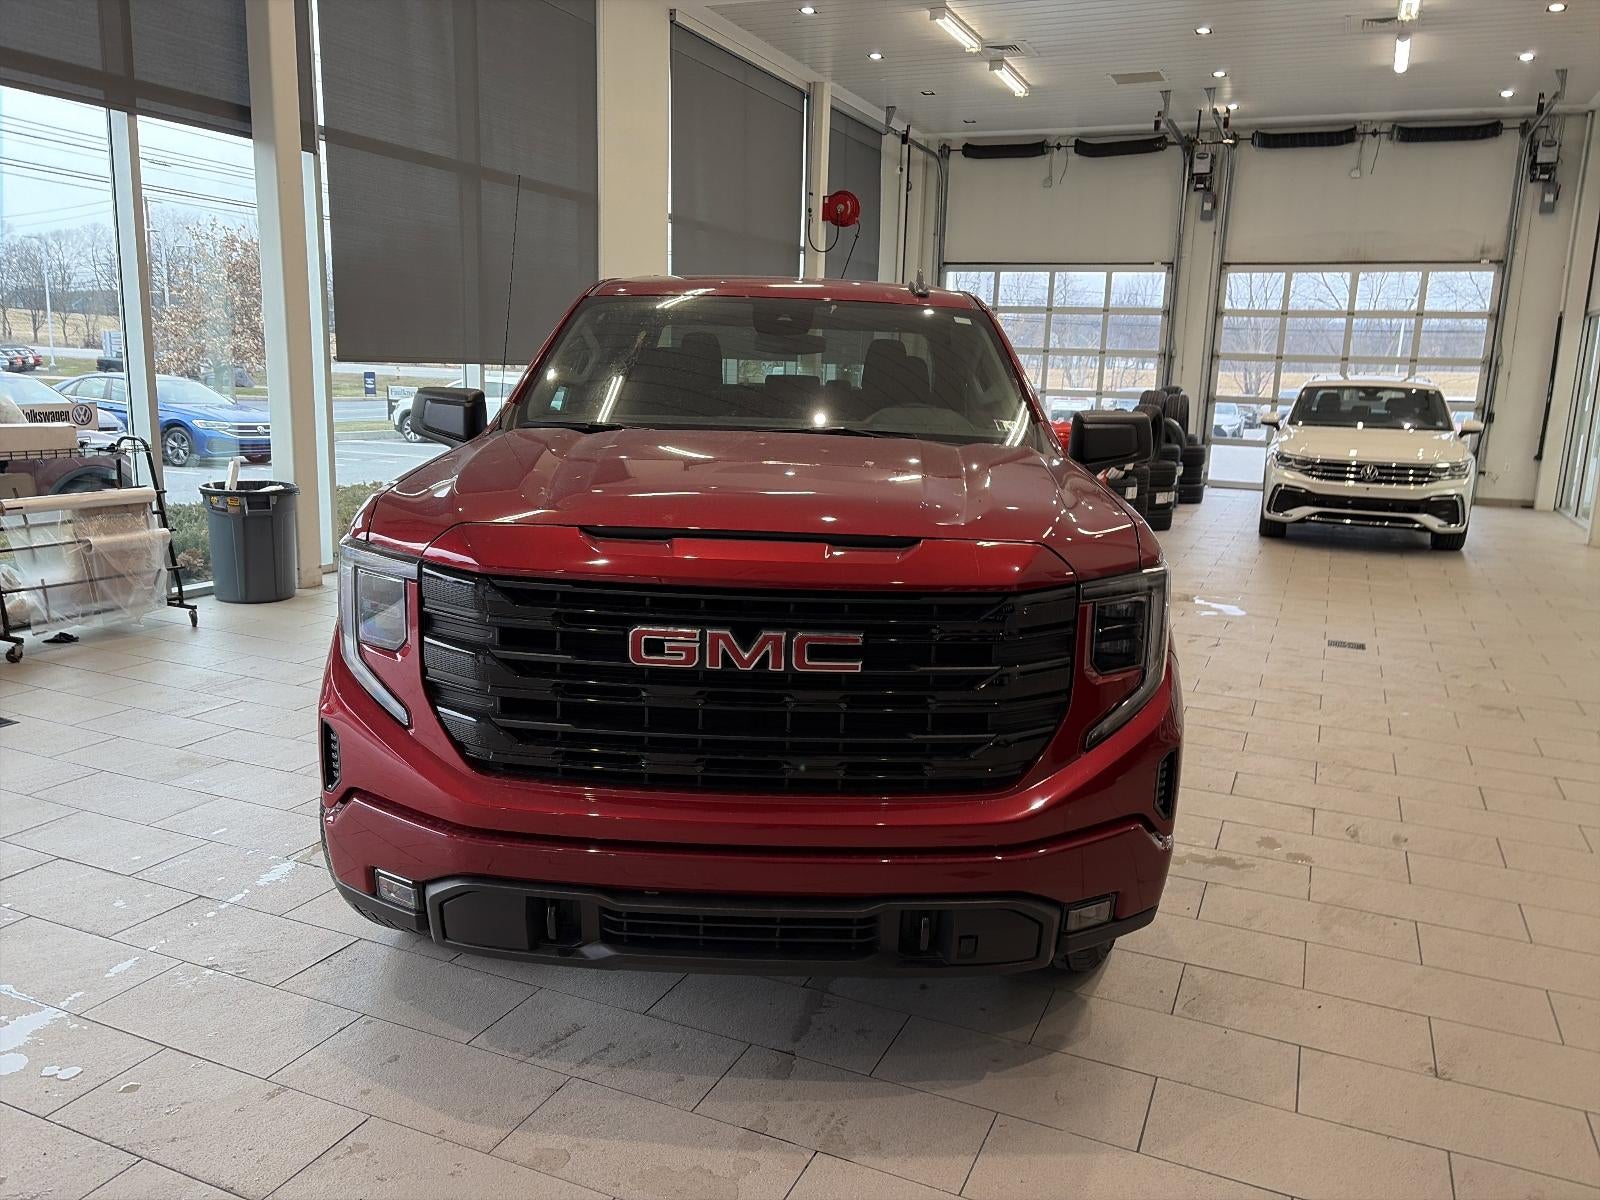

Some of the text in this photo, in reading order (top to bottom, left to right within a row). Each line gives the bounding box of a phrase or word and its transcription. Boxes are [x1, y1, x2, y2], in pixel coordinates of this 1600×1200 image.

[390, 388, 417, 397] Faulkne
[22, 409, 71, 423] olkswagen
[629, 625, 863, 672] GMC
